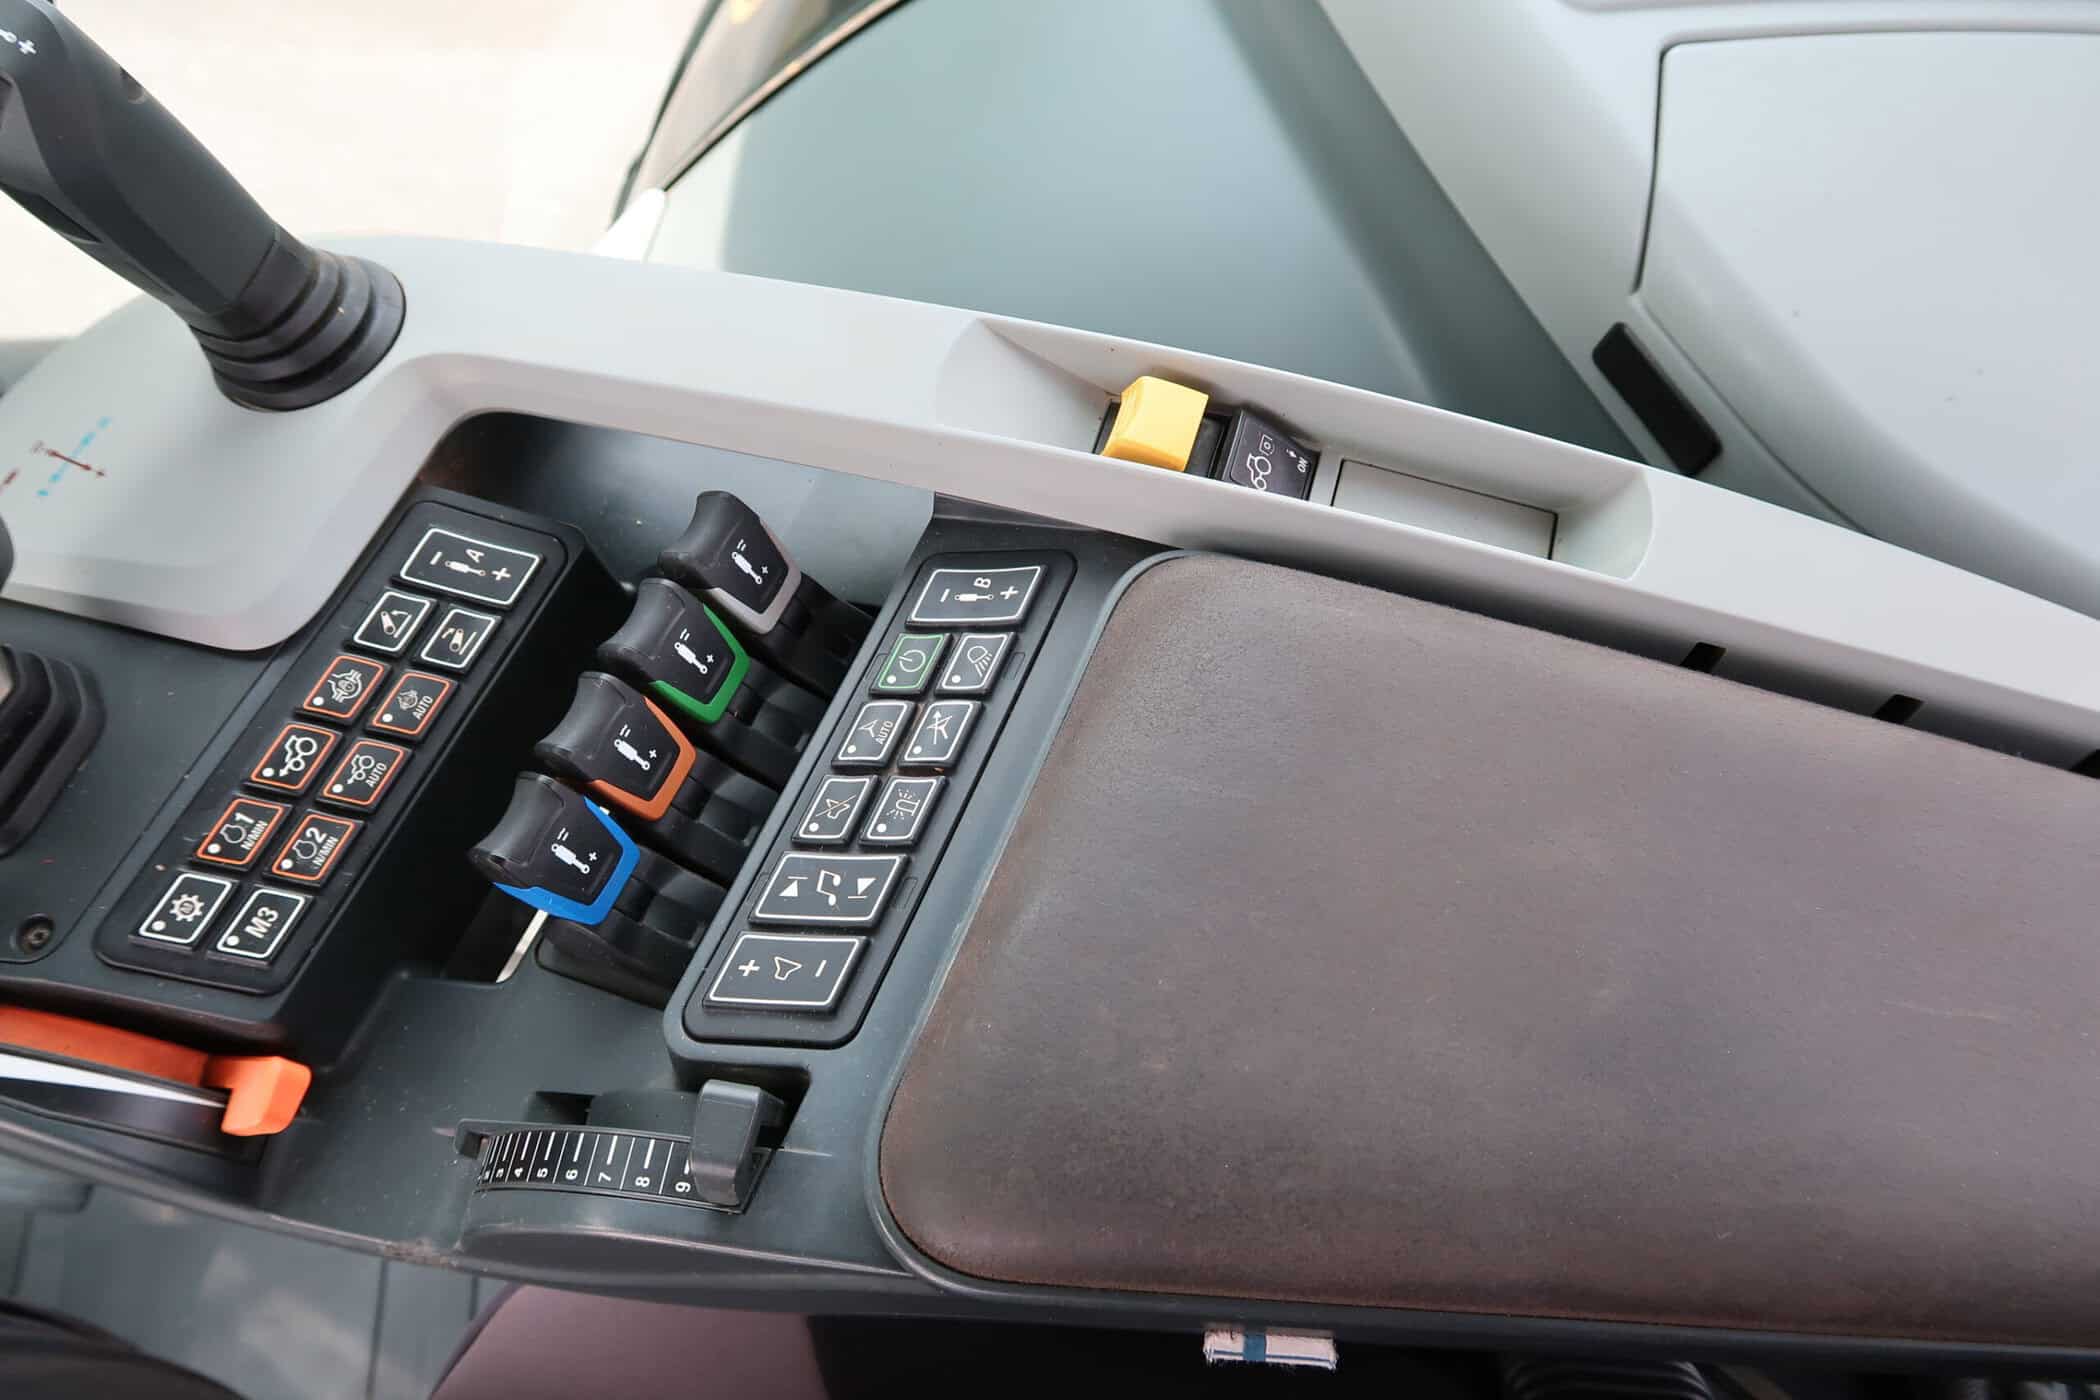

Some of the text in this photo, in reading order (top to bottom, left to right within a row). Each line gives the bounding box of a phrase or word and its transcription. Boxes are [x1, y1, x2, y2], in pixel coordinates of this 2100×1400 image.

[1297, 456, 1309, 473] ON
[465, 549, 485, 563] A
[973, 577, 992, 589] B
[412, 695, 433, 720] AUTO
[875, 720, 894, 745] AUTO
[365, 762, 388, 788] AUTO
[234, 812, 255, 824] 1
[305, 827, 328, 844] 2
[244, 906, 279, 938] M3
[514, 1167, 524, 1178] 4
[536, 1167, 549, 1178] 5
[565, 1169, 578, 1180] 6
[598, 1172, 612, 1182] 7
[635, 1176, 650, 1188] 8
[675, 1181, 691, 1193] 9
